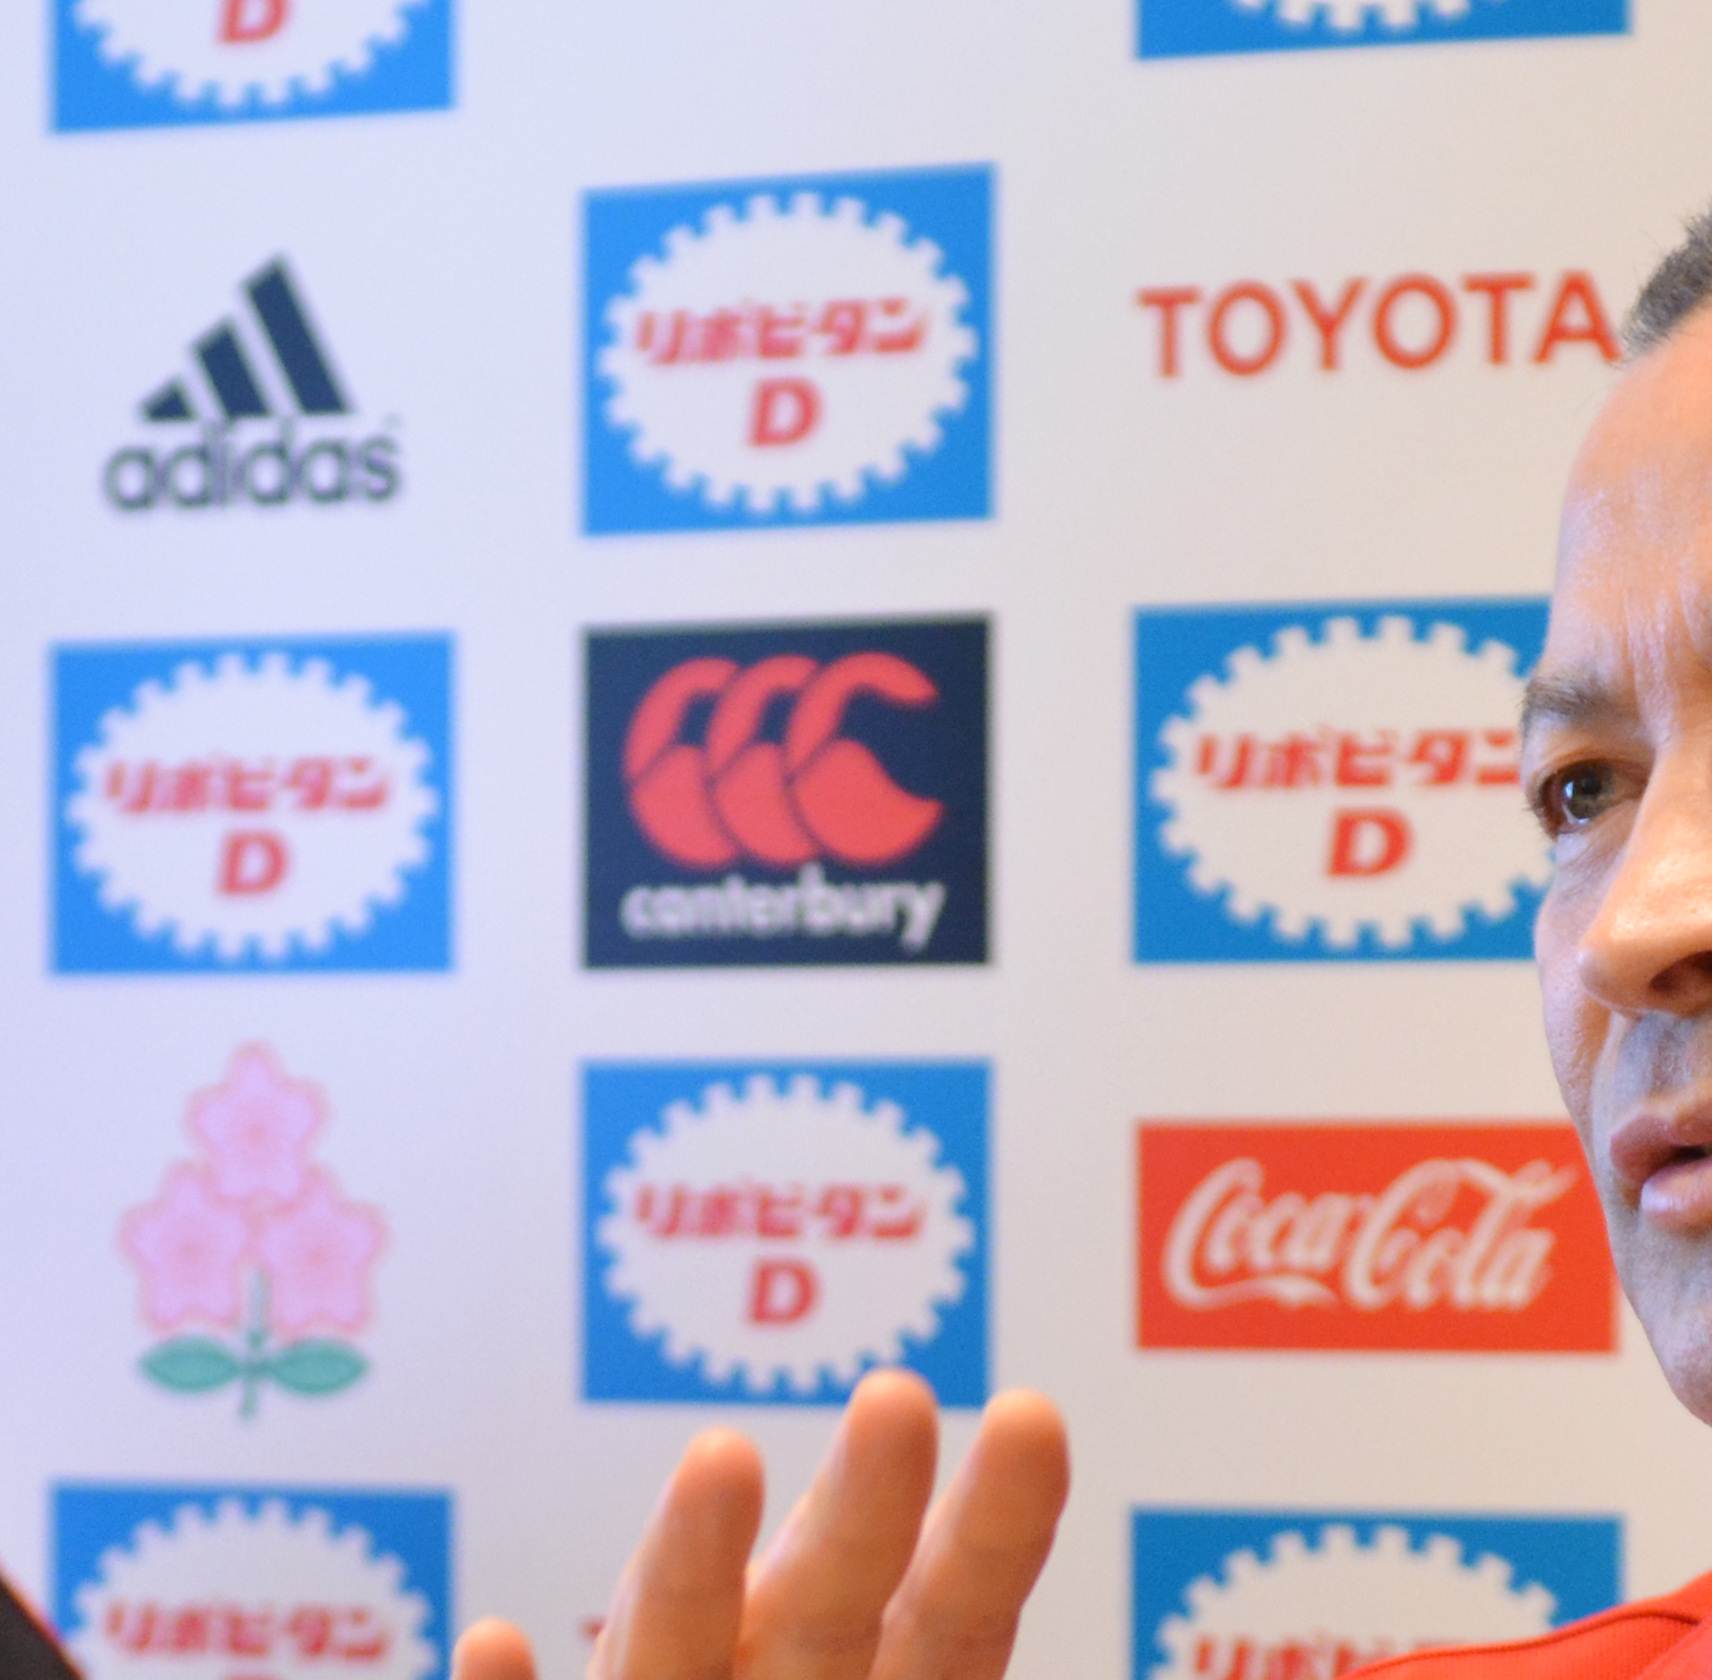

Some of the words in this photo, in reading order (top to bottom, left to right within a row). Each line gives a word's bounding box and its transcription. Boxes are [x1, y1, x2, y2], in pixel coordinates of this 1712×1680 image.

[637, 295, 926, 366] リポビタン
[1139, 271, 1622, 378] TOYOTA
[748, 377, 822, 449] D
[105, 424, 400, 514] adidas
[107, 755, 390, 816] リポビタン
[217, 829, 290, 899] D
[1327, 808, 1413, 878] D
[621, 864, 946, 948] canterbury
[637, 1183, 926, 1243] リポビタン
[1162, 1157, 1578, 1312] Coca-Cola
[747, 1257, 821, 1328] D
[106, 1600, 392, 1664] リポビタン
